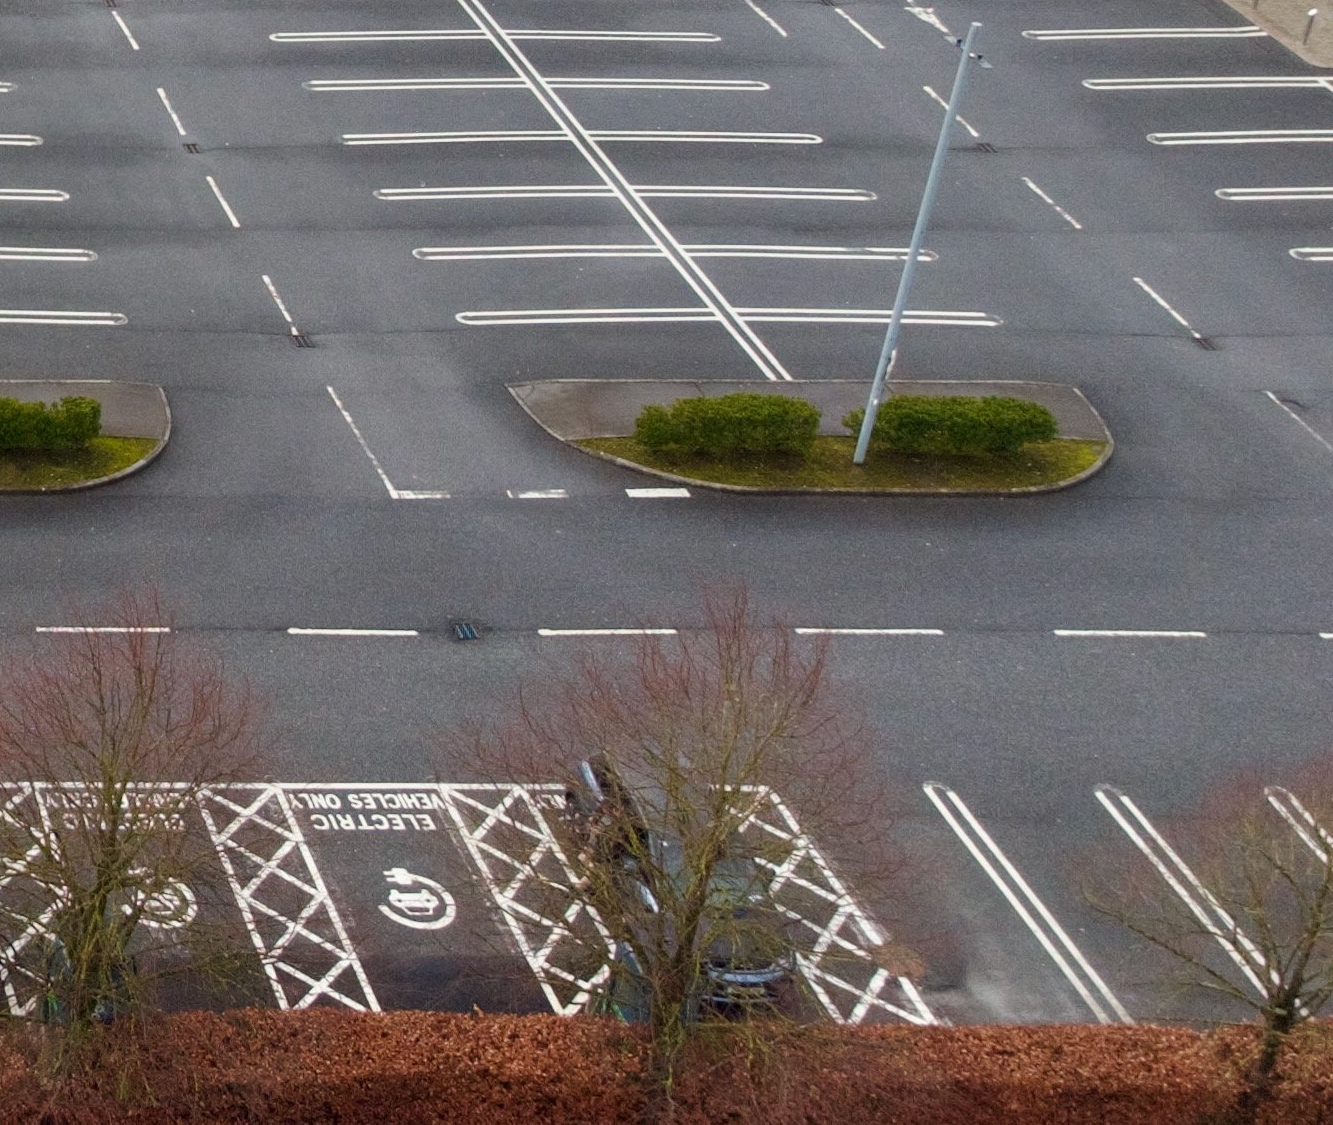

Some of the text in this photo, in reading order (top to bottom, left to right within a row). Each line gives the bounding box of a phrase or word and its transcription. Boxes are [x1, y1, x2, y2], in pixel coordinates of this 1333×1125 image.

[290, 792, 446, 810] VEHICLES ONLY
[311, 813, 436, 831] ELECTRIC
